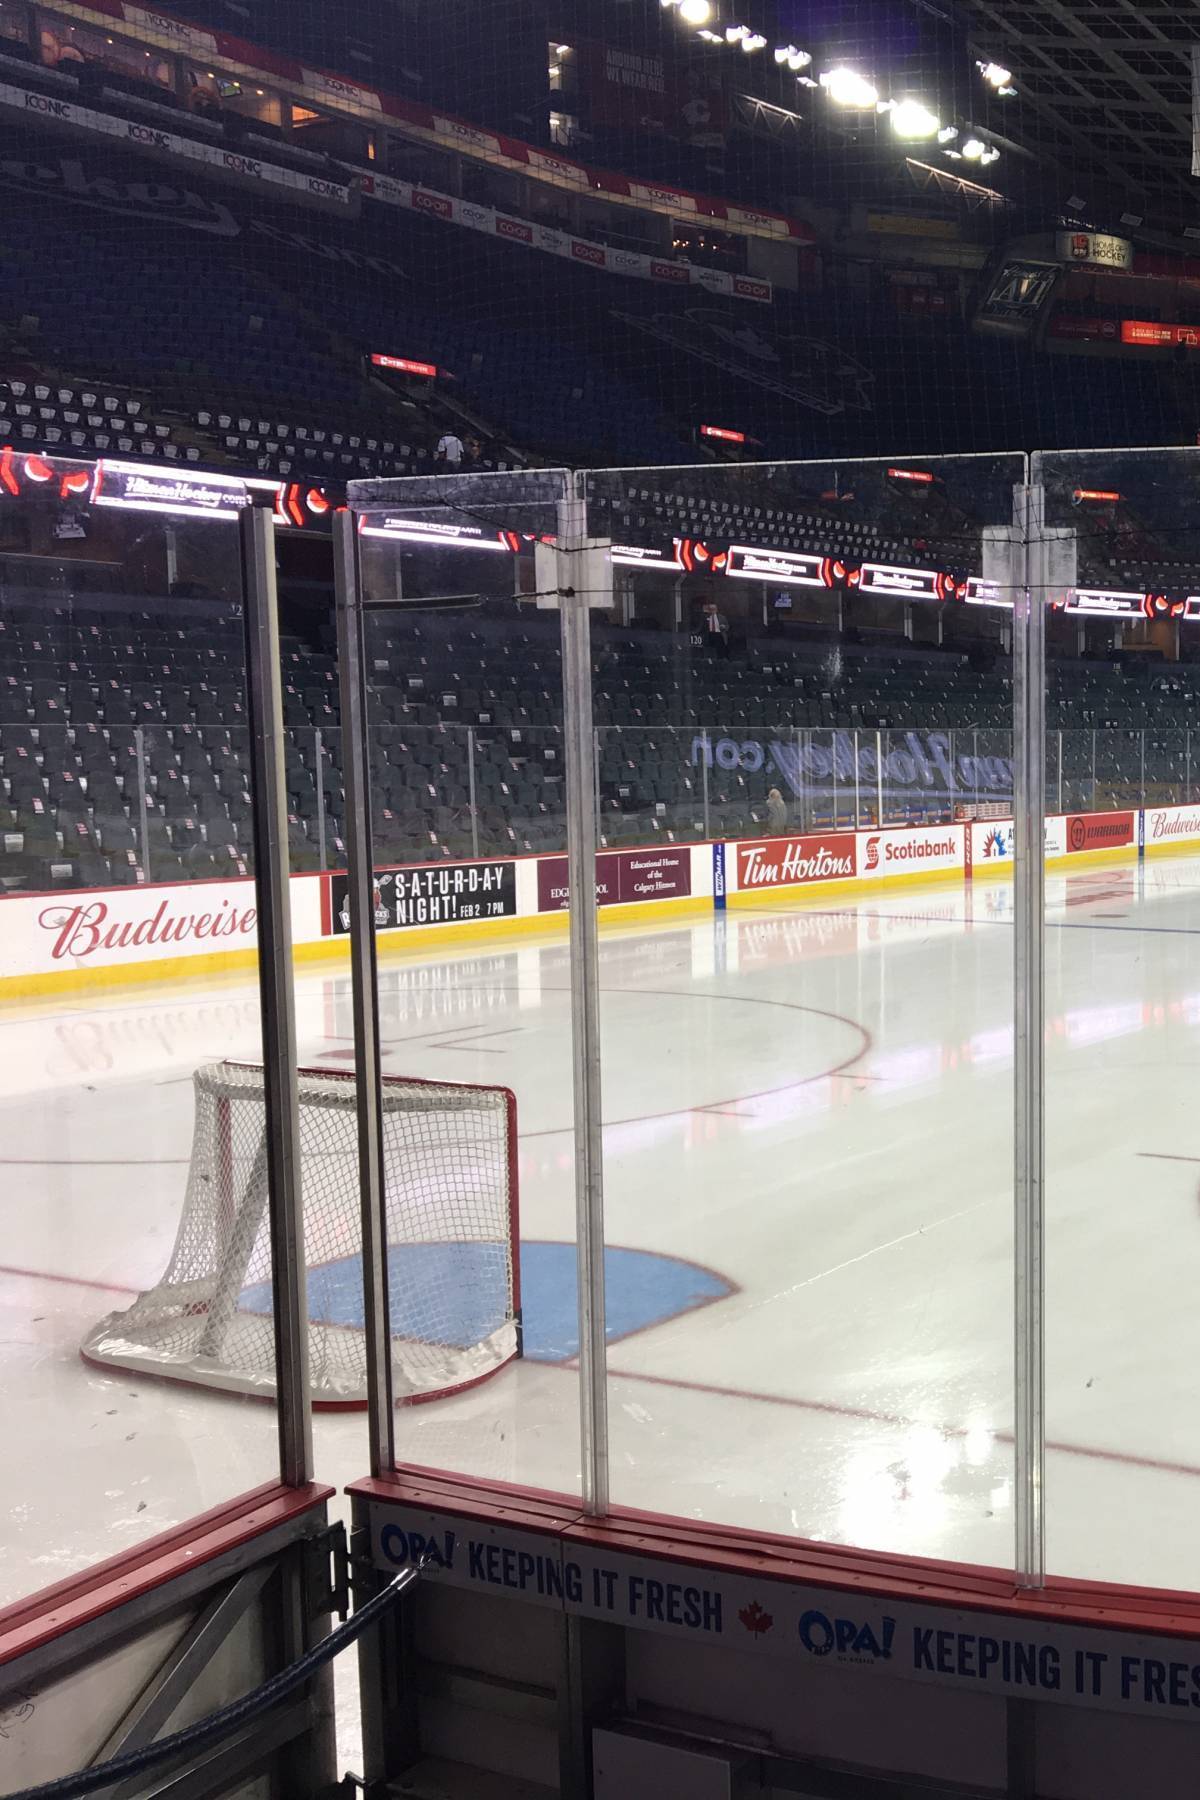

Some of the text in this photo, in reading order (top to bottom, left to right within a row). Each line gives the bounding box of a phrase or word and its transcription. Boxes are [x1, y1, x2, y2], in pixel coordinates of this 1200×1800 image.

[25, 94, 70, 119] ICONIC
[128, 123, 170, 149] ICONIC
[223, 153, 261, 175] ICONIC
[309, 177, 344, 198] ICONIC
[1093, 249, 1127, 262] HOCKEY
[1087, 823, 1130, 838] WARRIOR
[885, 837, 956, 862] Scotiabank
[630, 858, 679, 870] Educational Home
[647, 871, 663, 879] of the
[741, 847, 778, 885] Tim
[395, 867, 504, 898] S-A-T-U-R-D-A-Y
[633, 881, 676, 895] Calgary Hitmen
[395, 896, 457, 924] NIGHT!
[460, 904, 473, 918] FEB
[474, 904, 480, 916] 2
[487, 903, 492, 915] 7
[492, 902, 504, 915] PM
[38, 899, 257, 959] Budweise
[380, 1523, 723, 1633] OPA! KEEPING IT FRESH
[799, 1609, 898, 1660] OPA!
[913, 1625, 1061, 1691] KEEPING
[1074, 1650, 1108, 1696] IT
